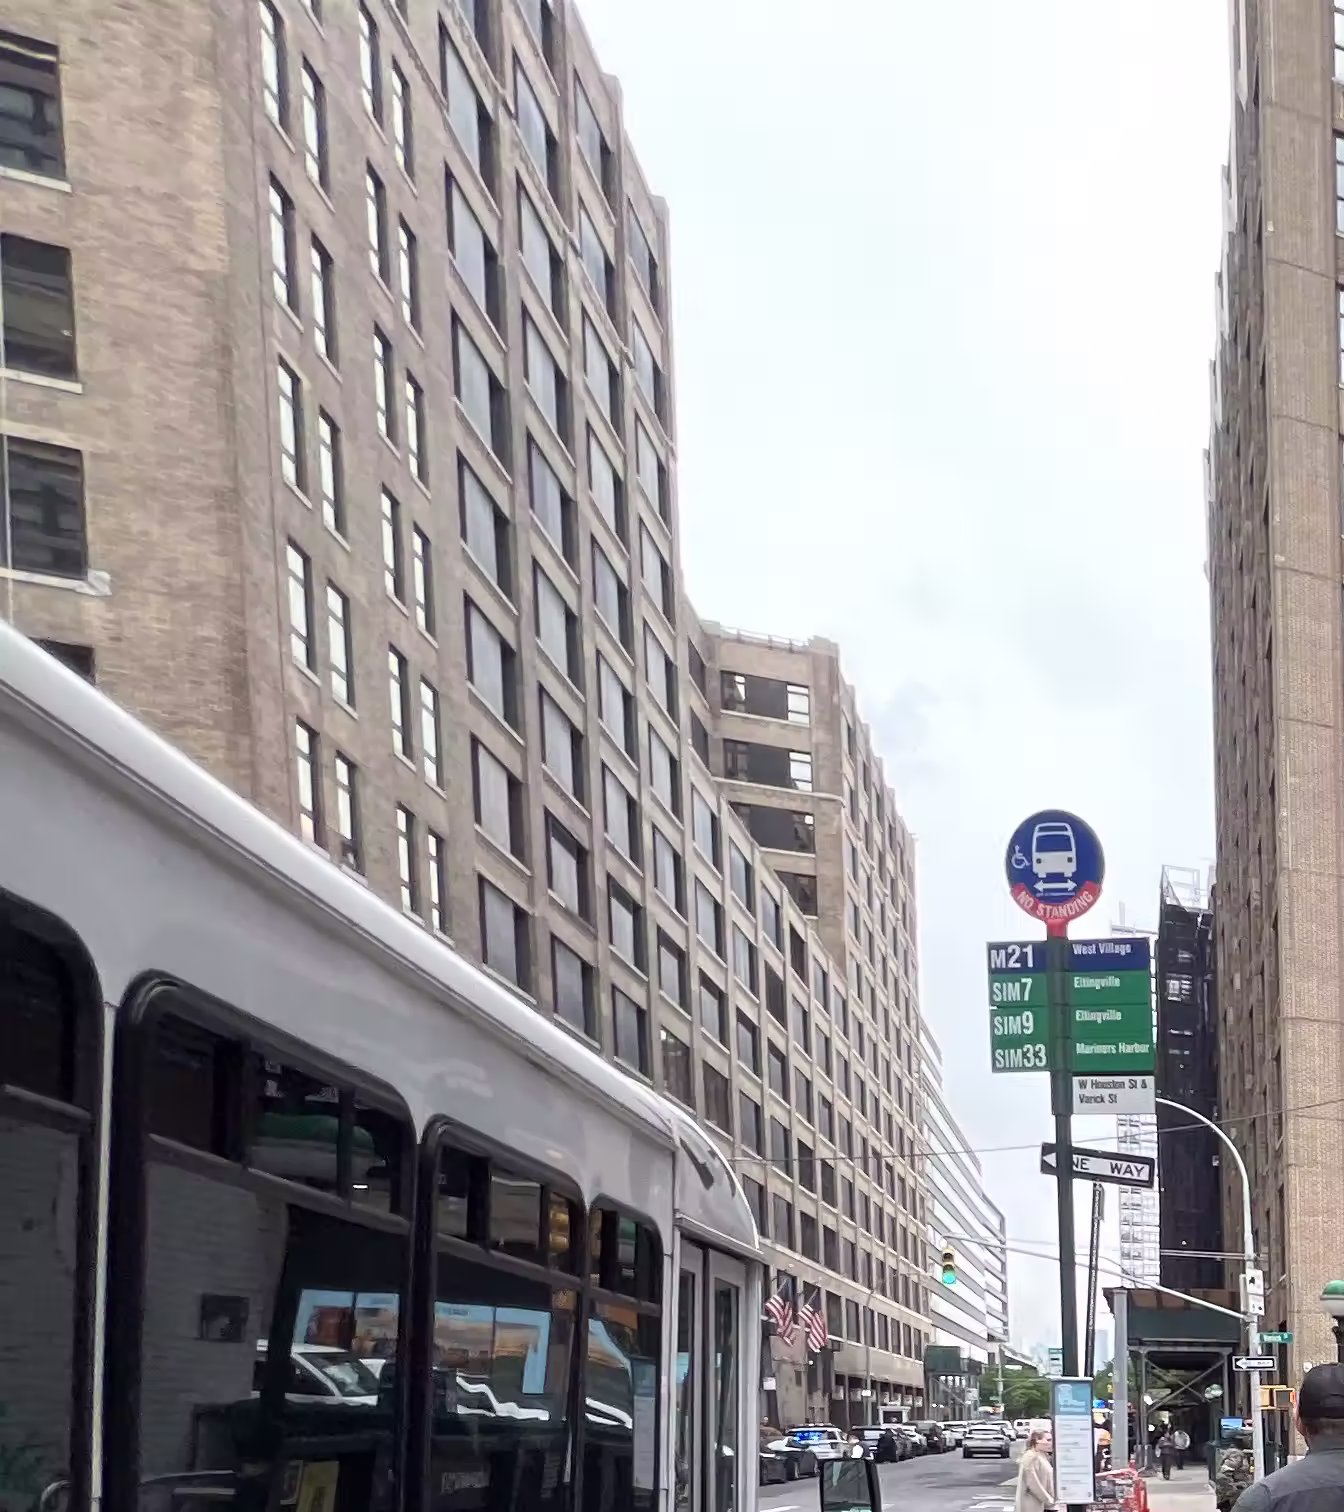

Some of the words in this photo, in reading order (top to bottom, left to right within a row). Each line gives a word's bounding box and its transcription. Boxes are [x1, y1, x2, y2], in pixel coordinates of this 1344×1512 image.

[1016, 891, 1034, 909] NO
[1036, 890, 1094, 918] STANDING
[990, 944, 1034, 969] M21
[1072, 944, 1096, 955] West
[1099, 942, 1131, 956] Village
[993, 977, 1032, 1001] SIM7
[1074, 976, 1120, 989] Eltingville
[994, 1011, 1034, 1035] SIM9
[995, 1044, 1046, 1068] SIM33
[1076, 1043, 1116, 1054] Mariners
[1118, 1041, 1149, 1053] Harbor
[1078, 1079, 1087, 1089] W
[1091, 1078, 1125, 1089] Houston
[1128, 1079, 1138, 1089] St
[1141, 1079, 1148, 1089] &
[1078, 1093, 1105, 1104] Varick
[1108, 1093, 1118, 1104] St
[1073, 1157, 1090, 1171] NE
[1109, 1161, 1145, 1177] WAY
